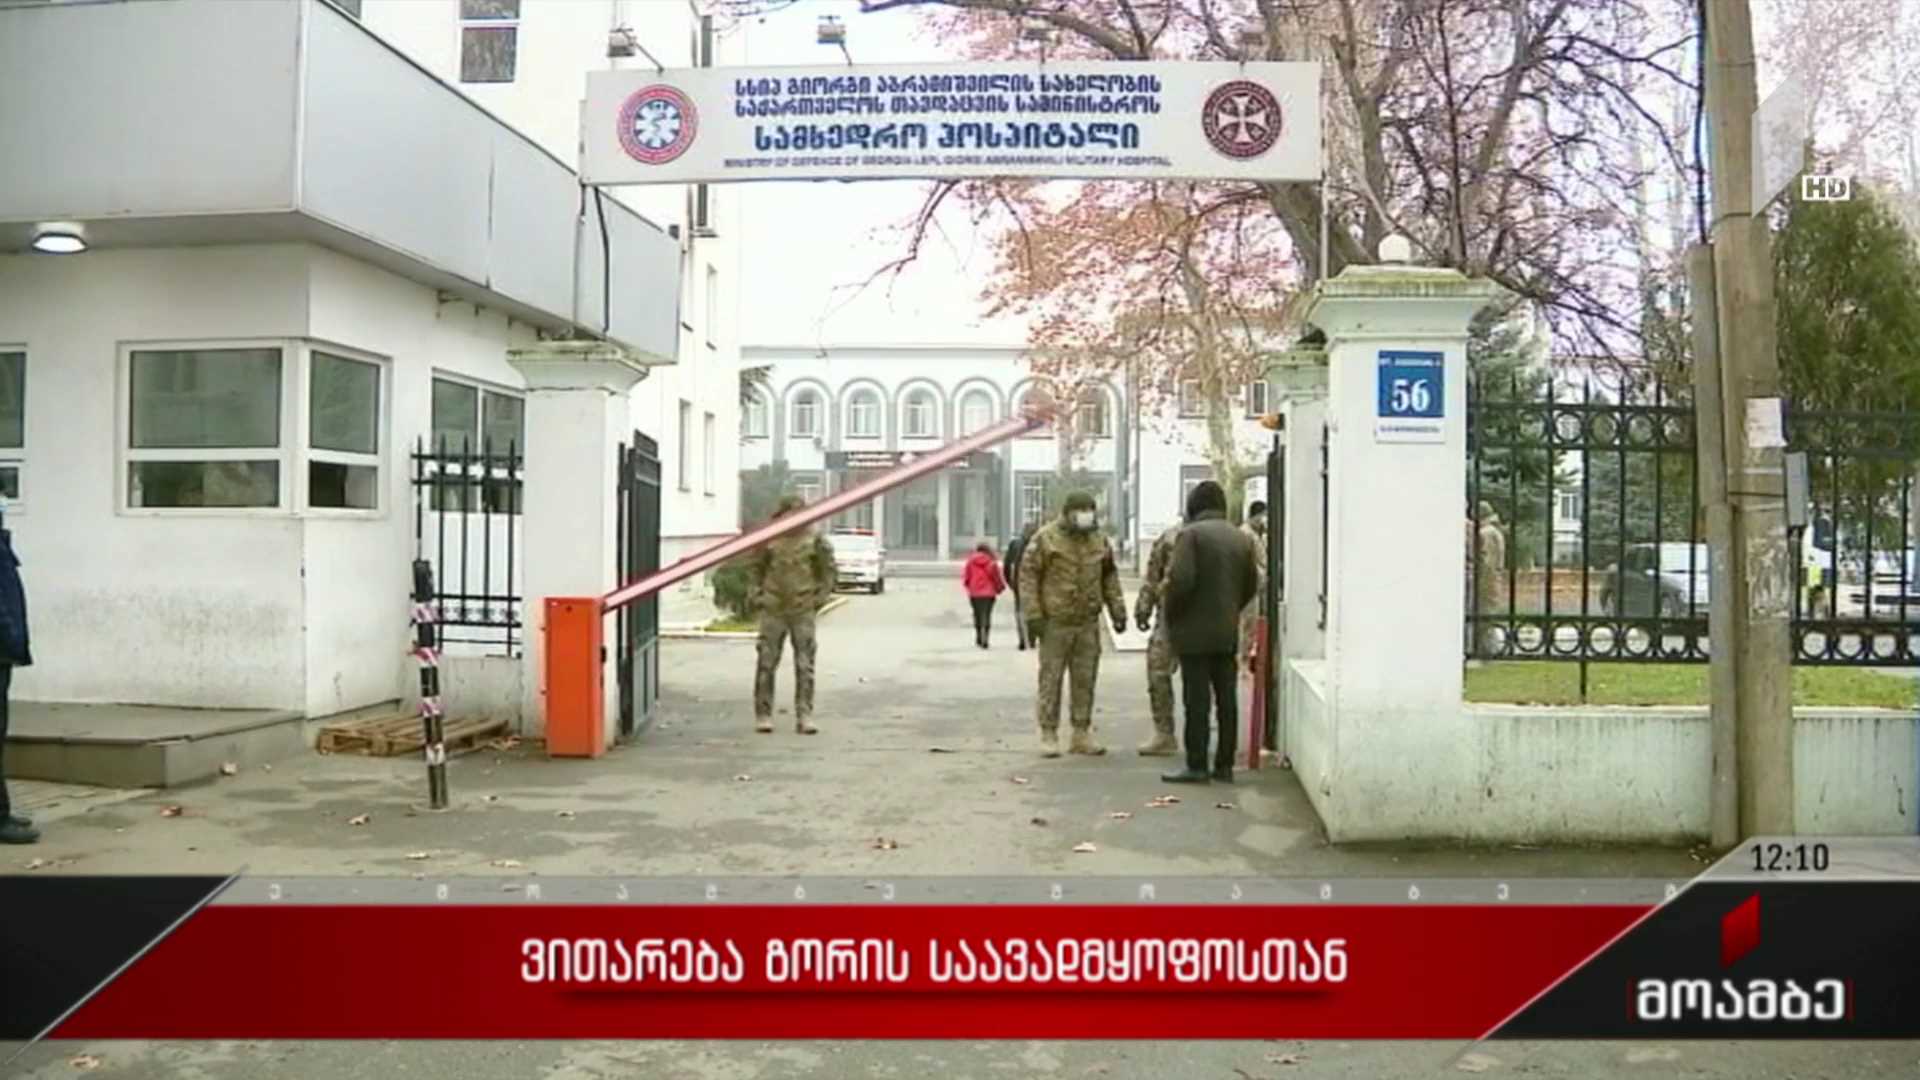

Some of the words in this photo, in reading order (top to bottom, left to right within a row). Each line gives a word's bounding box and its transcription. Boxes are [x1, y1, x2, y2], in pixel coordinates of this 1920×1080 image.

[787, 76, 871, 95] გიორგი
[1040, 74, 1161, 93] სახელობის
[736, 96, 885, 117] საქართველოს
[891, 95, 1009, 114] თავდაცვის
[1015, 95, 1161, 114] სამინისტროს
[755, 123, 927, 150] სამხედრო
[938, 122, 1139, 149] ჰოსპიტალი
[1391, 379, 1430, 412] 56
